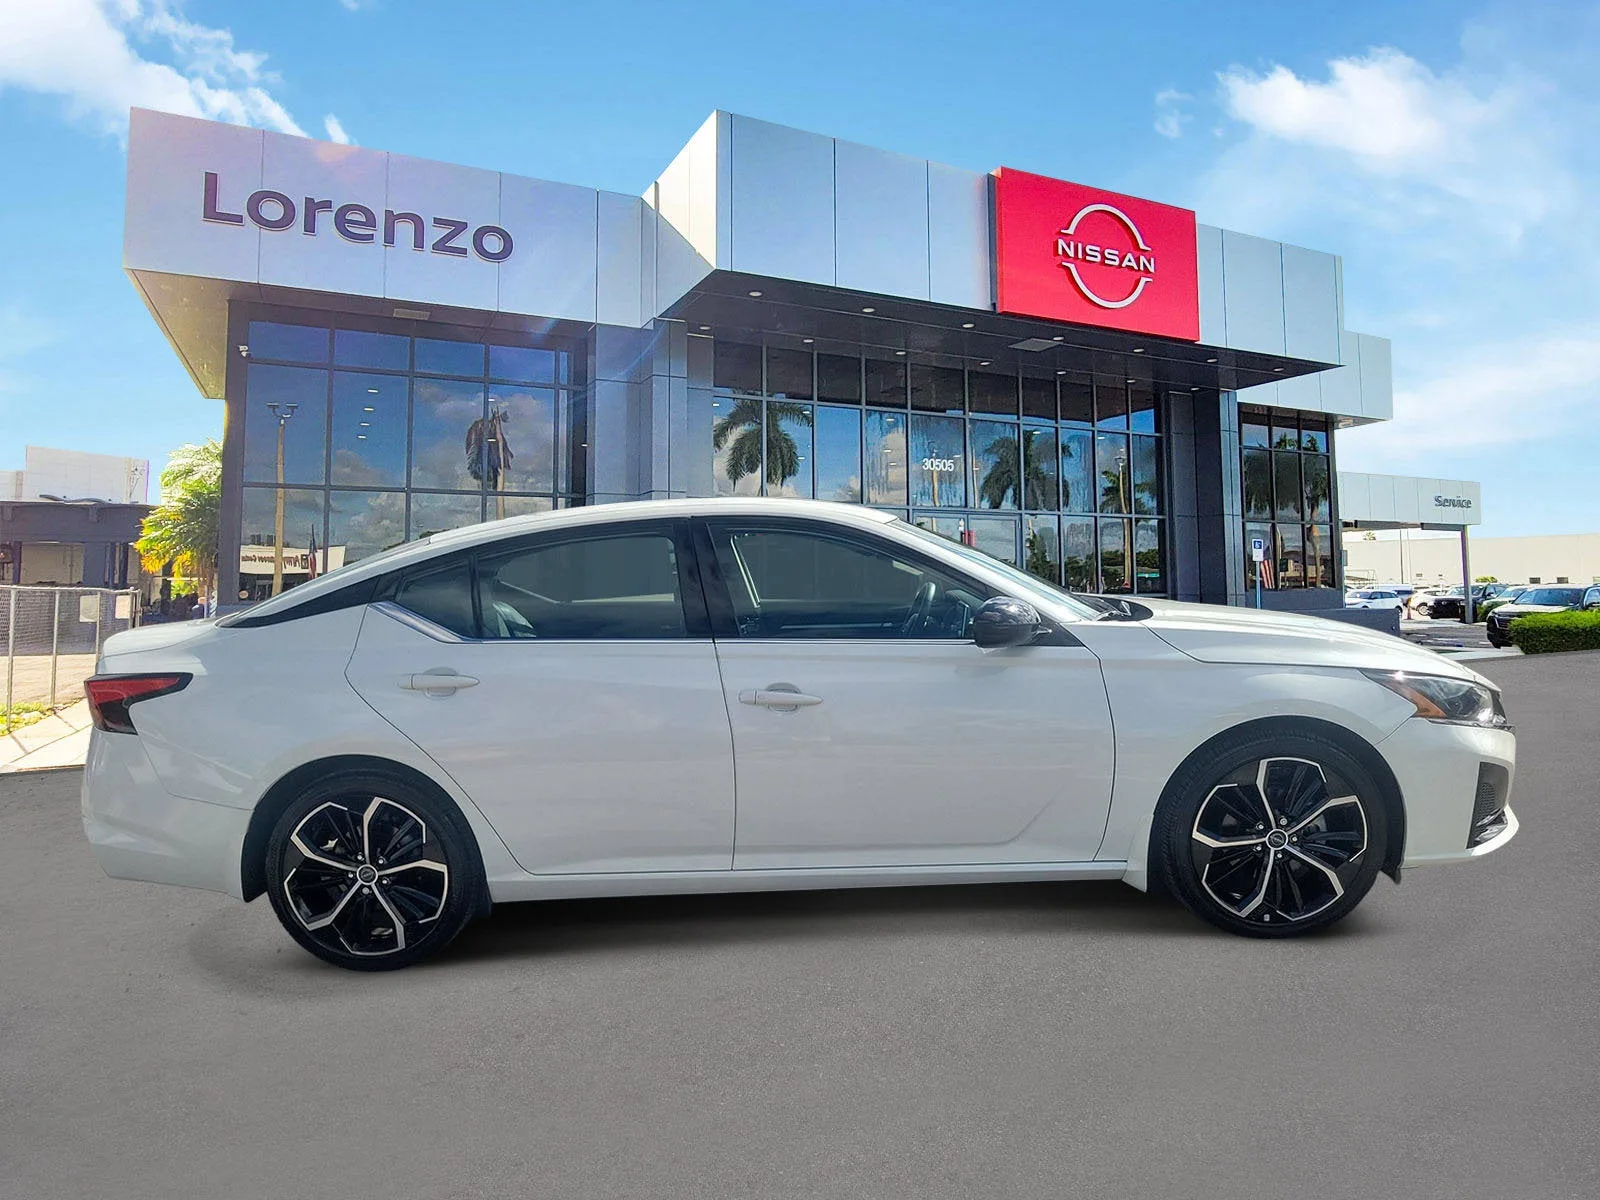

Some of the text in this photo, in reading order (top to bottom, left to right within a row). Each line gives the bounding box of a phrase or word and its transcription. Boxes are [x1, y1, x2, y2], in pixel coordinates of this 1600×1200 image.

[203, 171, 514, 262] Lorenzo
[1057, 238, 1155, 273] NISSAN
[922, 458, 955, 472] 30505
[1434, 495, 1472, 509] Service
